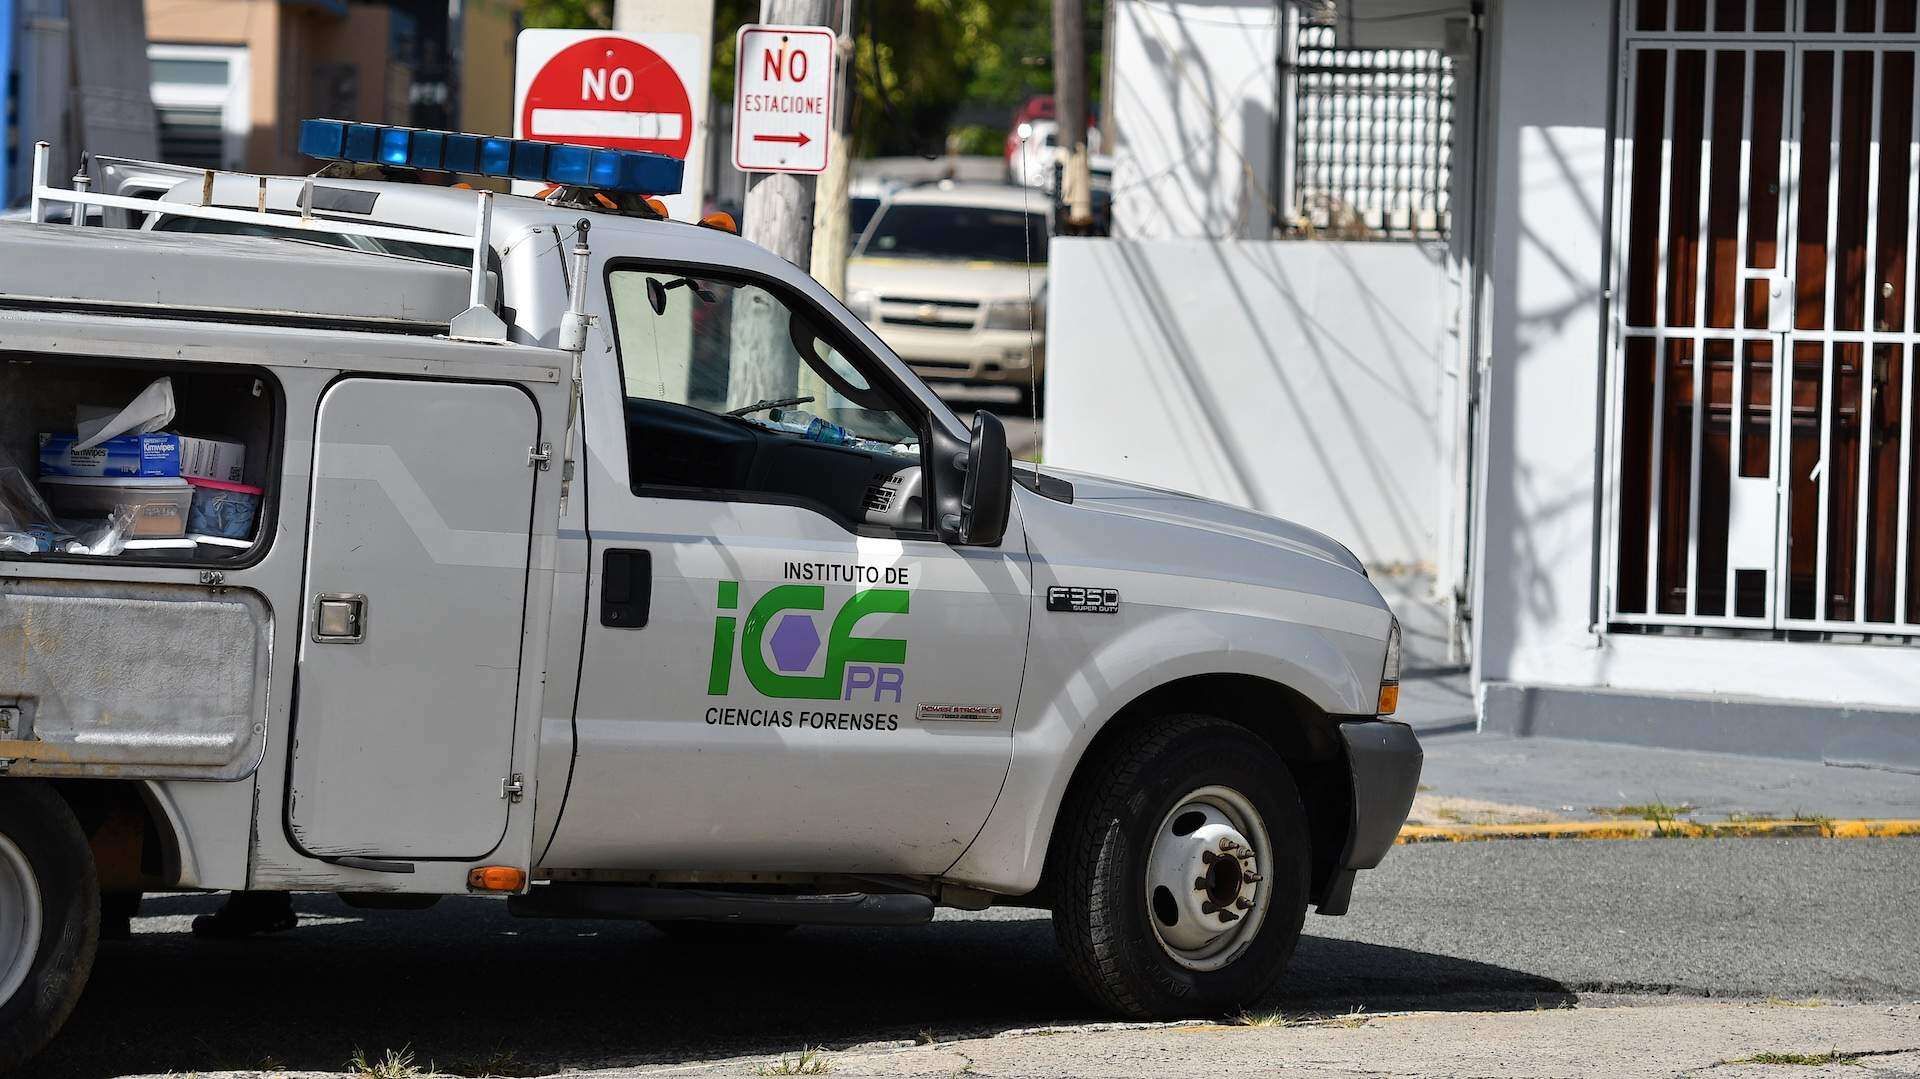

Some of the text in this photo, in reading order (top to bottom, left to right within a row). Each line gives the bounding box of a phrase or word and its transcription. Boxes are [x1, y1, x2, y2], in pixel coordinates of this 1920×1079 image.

[764, 48, 807, 82] NO
[581, 67, 634, 102] NO
[744, 94, 822, 114] ESTACIONE
[143, 442, 175, 453] Kimwipes
[784, 561, 909, 585] INSTITUTO DE
[844, 665, 904, 703] PR
[705, 707, 899, 731] CIENCIAS FORENSES
